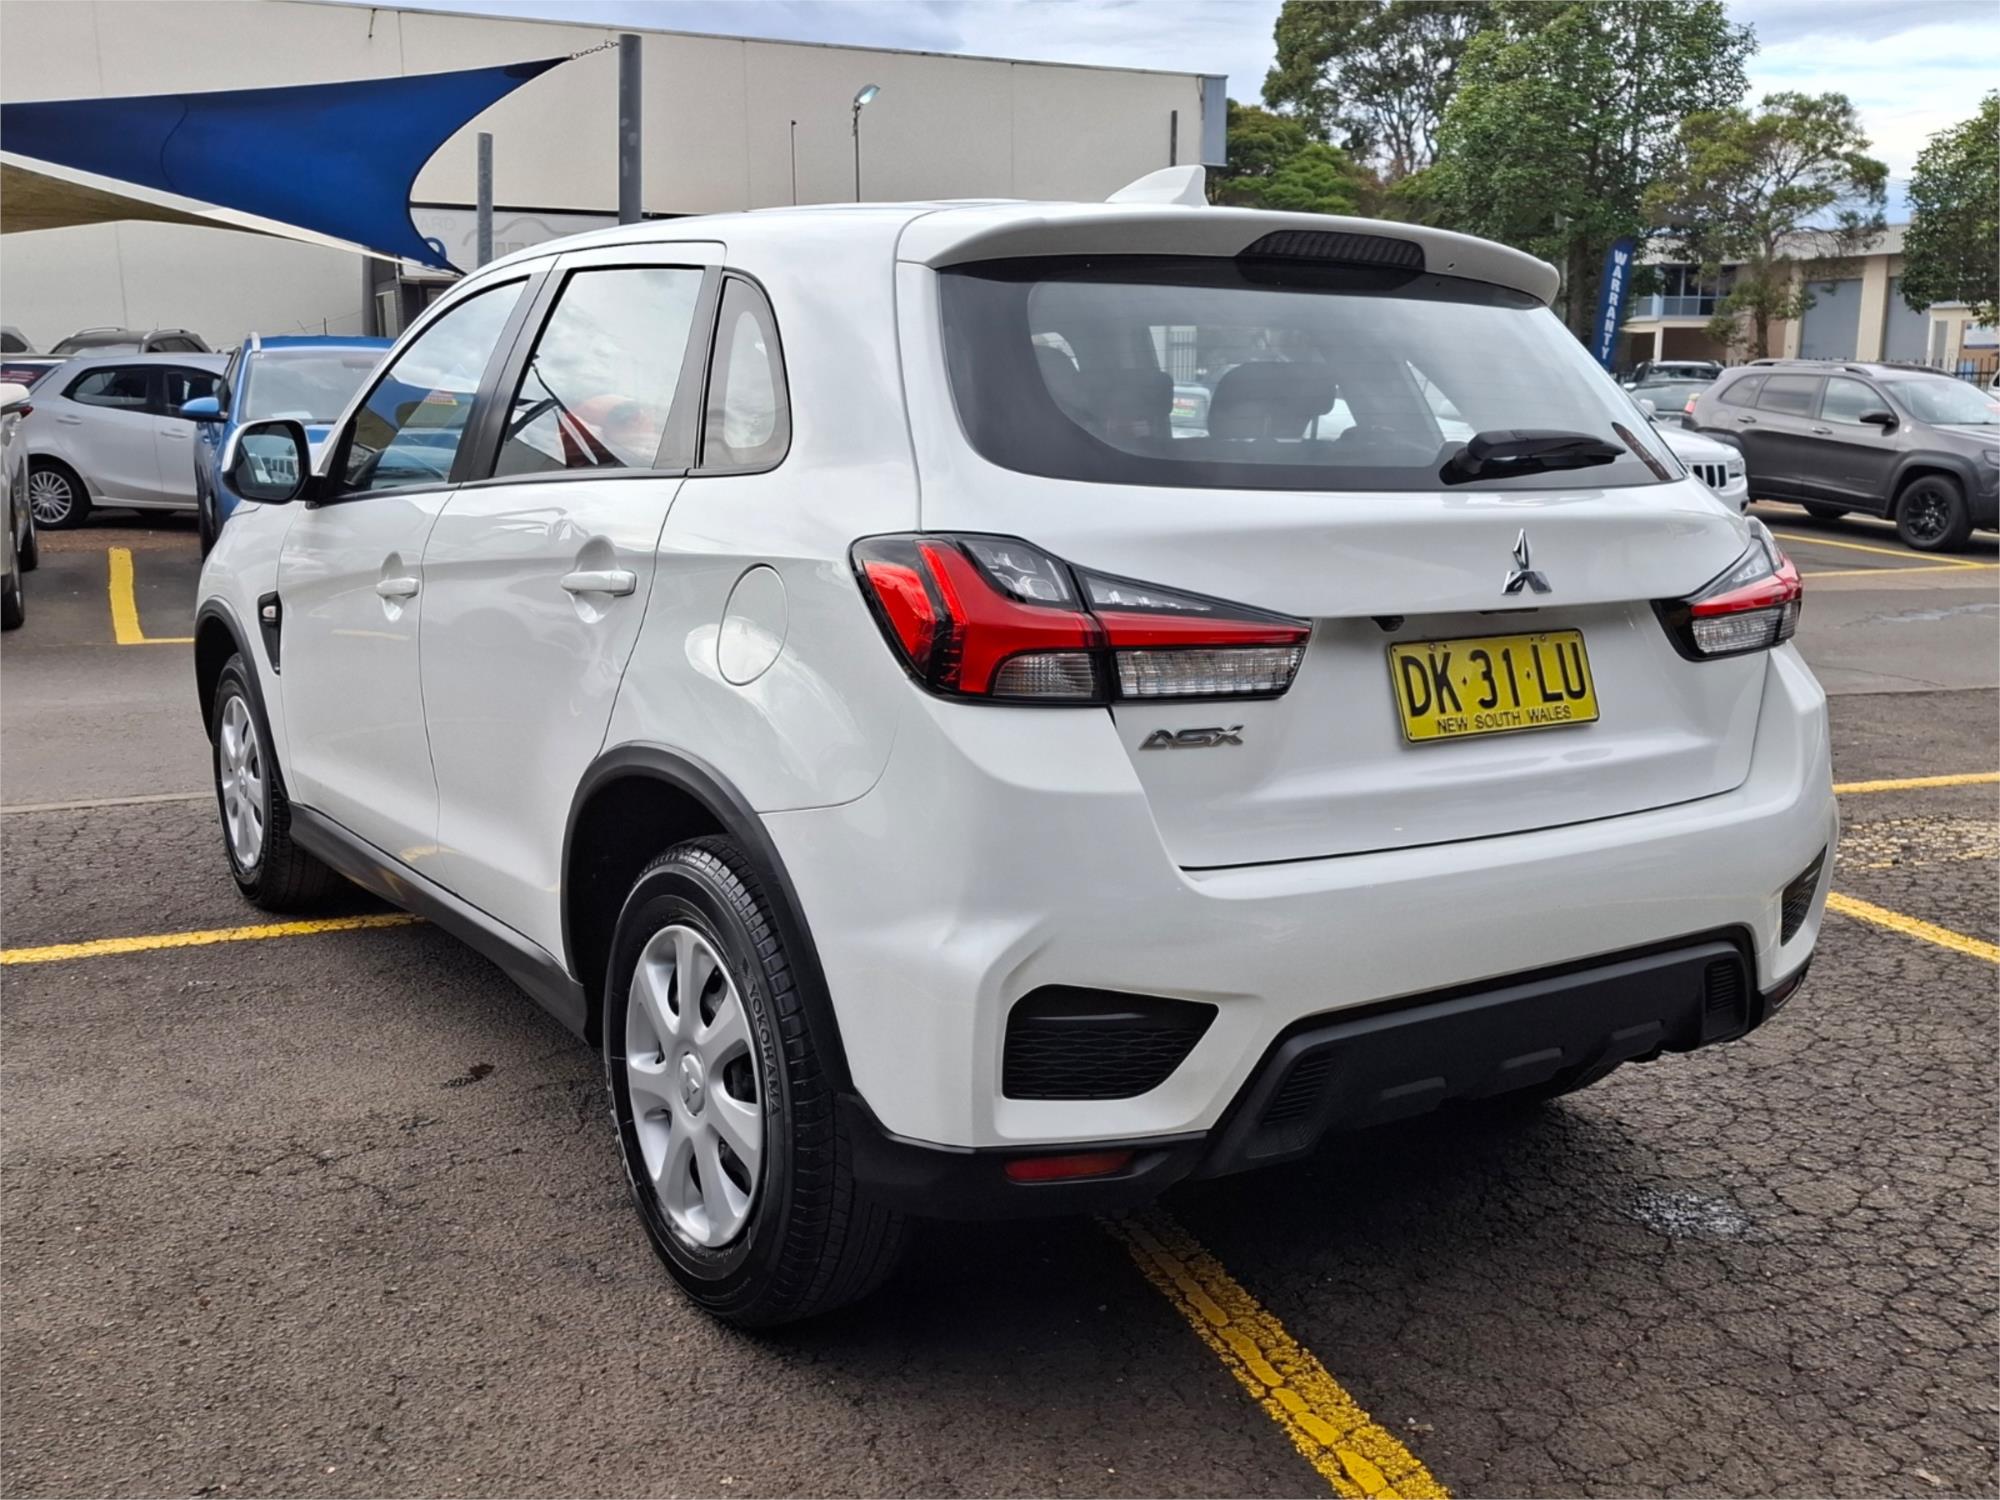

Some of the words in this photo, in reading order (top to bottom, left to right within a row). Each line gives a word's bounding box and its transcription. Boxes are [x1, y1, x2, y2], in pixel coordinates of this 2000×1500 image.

[1602, 249, 1628, 360] WARRANTY
[1138, 725, 1244, 751] ASX
[1437, 716, 1468, 735] NEW
[1476, 710, 1521, 730] SOUTH
[1530, 706, 1572, 724] WALES
[749, 983, 781, 1116] YOKOHAMA
